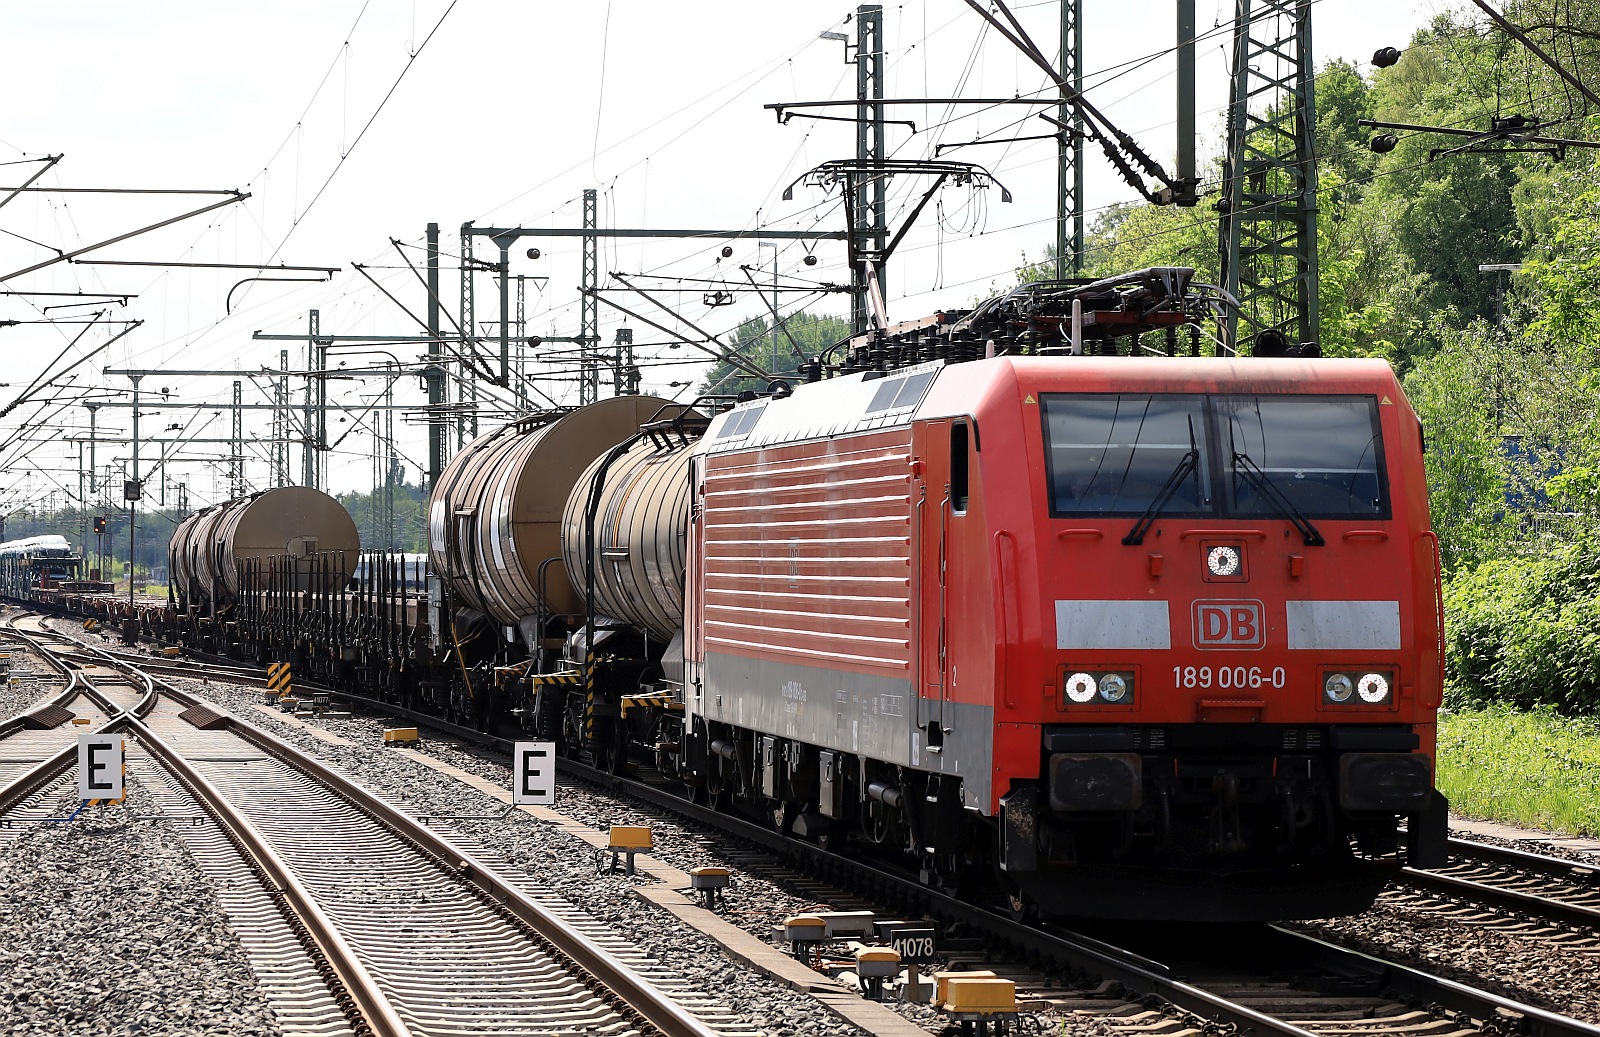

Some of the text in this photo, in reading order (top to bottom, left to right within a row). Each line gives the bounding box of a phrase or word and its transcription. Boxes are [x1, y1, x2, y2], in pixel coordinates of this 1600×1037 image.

[1202, 608, 1256, 641] DB
[952, 665, 957, 687] 2
[1173, 666, 1286, 689] 189 006-0
[88, 743, 113, 790] E
[522, 750, 547, 796] E
